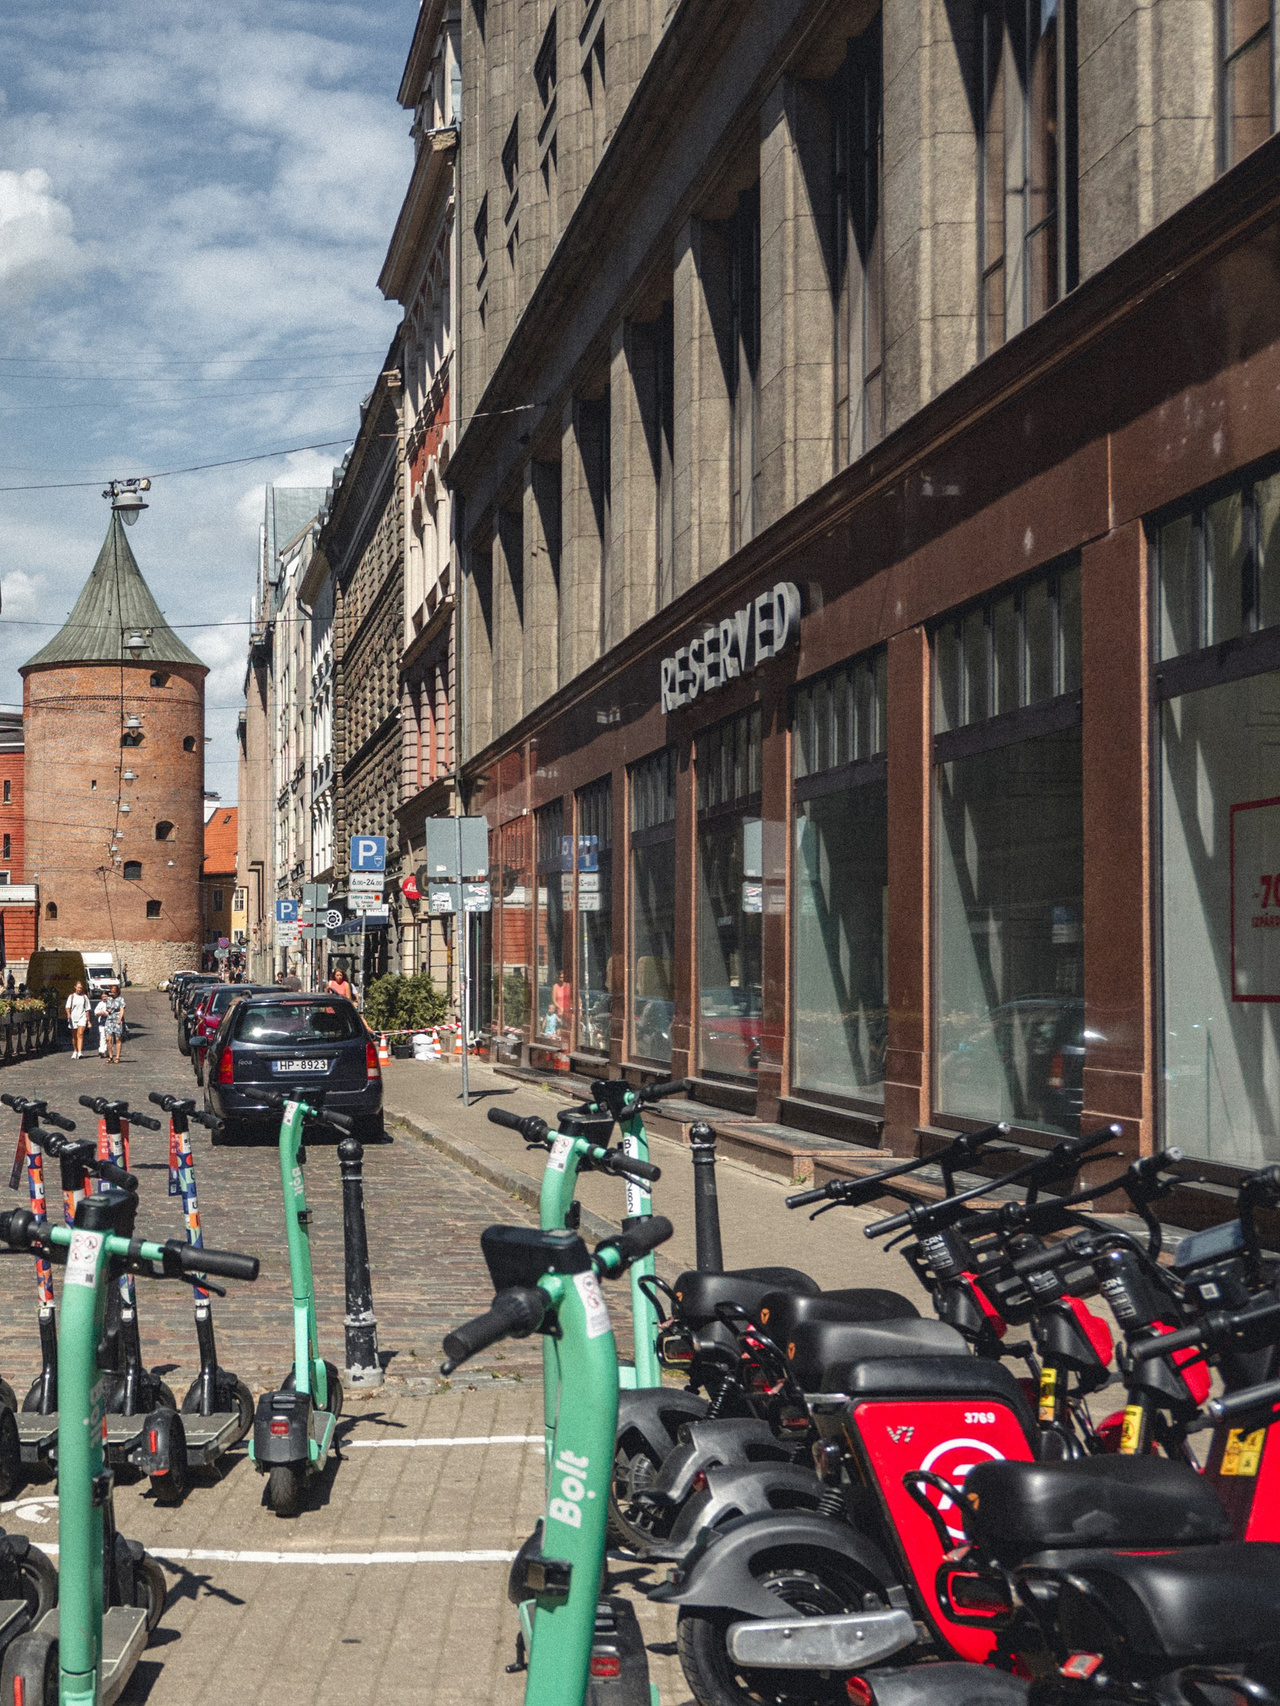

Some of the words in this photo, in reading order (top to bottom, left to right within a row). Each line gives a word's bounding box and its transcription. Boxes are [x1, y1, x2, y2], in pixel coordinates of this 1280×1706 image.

[661, 582, 801, 714] RESERVED
[358, 840, 377, 866] P
[964, 1412, 996, 1424] 3769
[549, 1449, 596, 1529] Bolt
